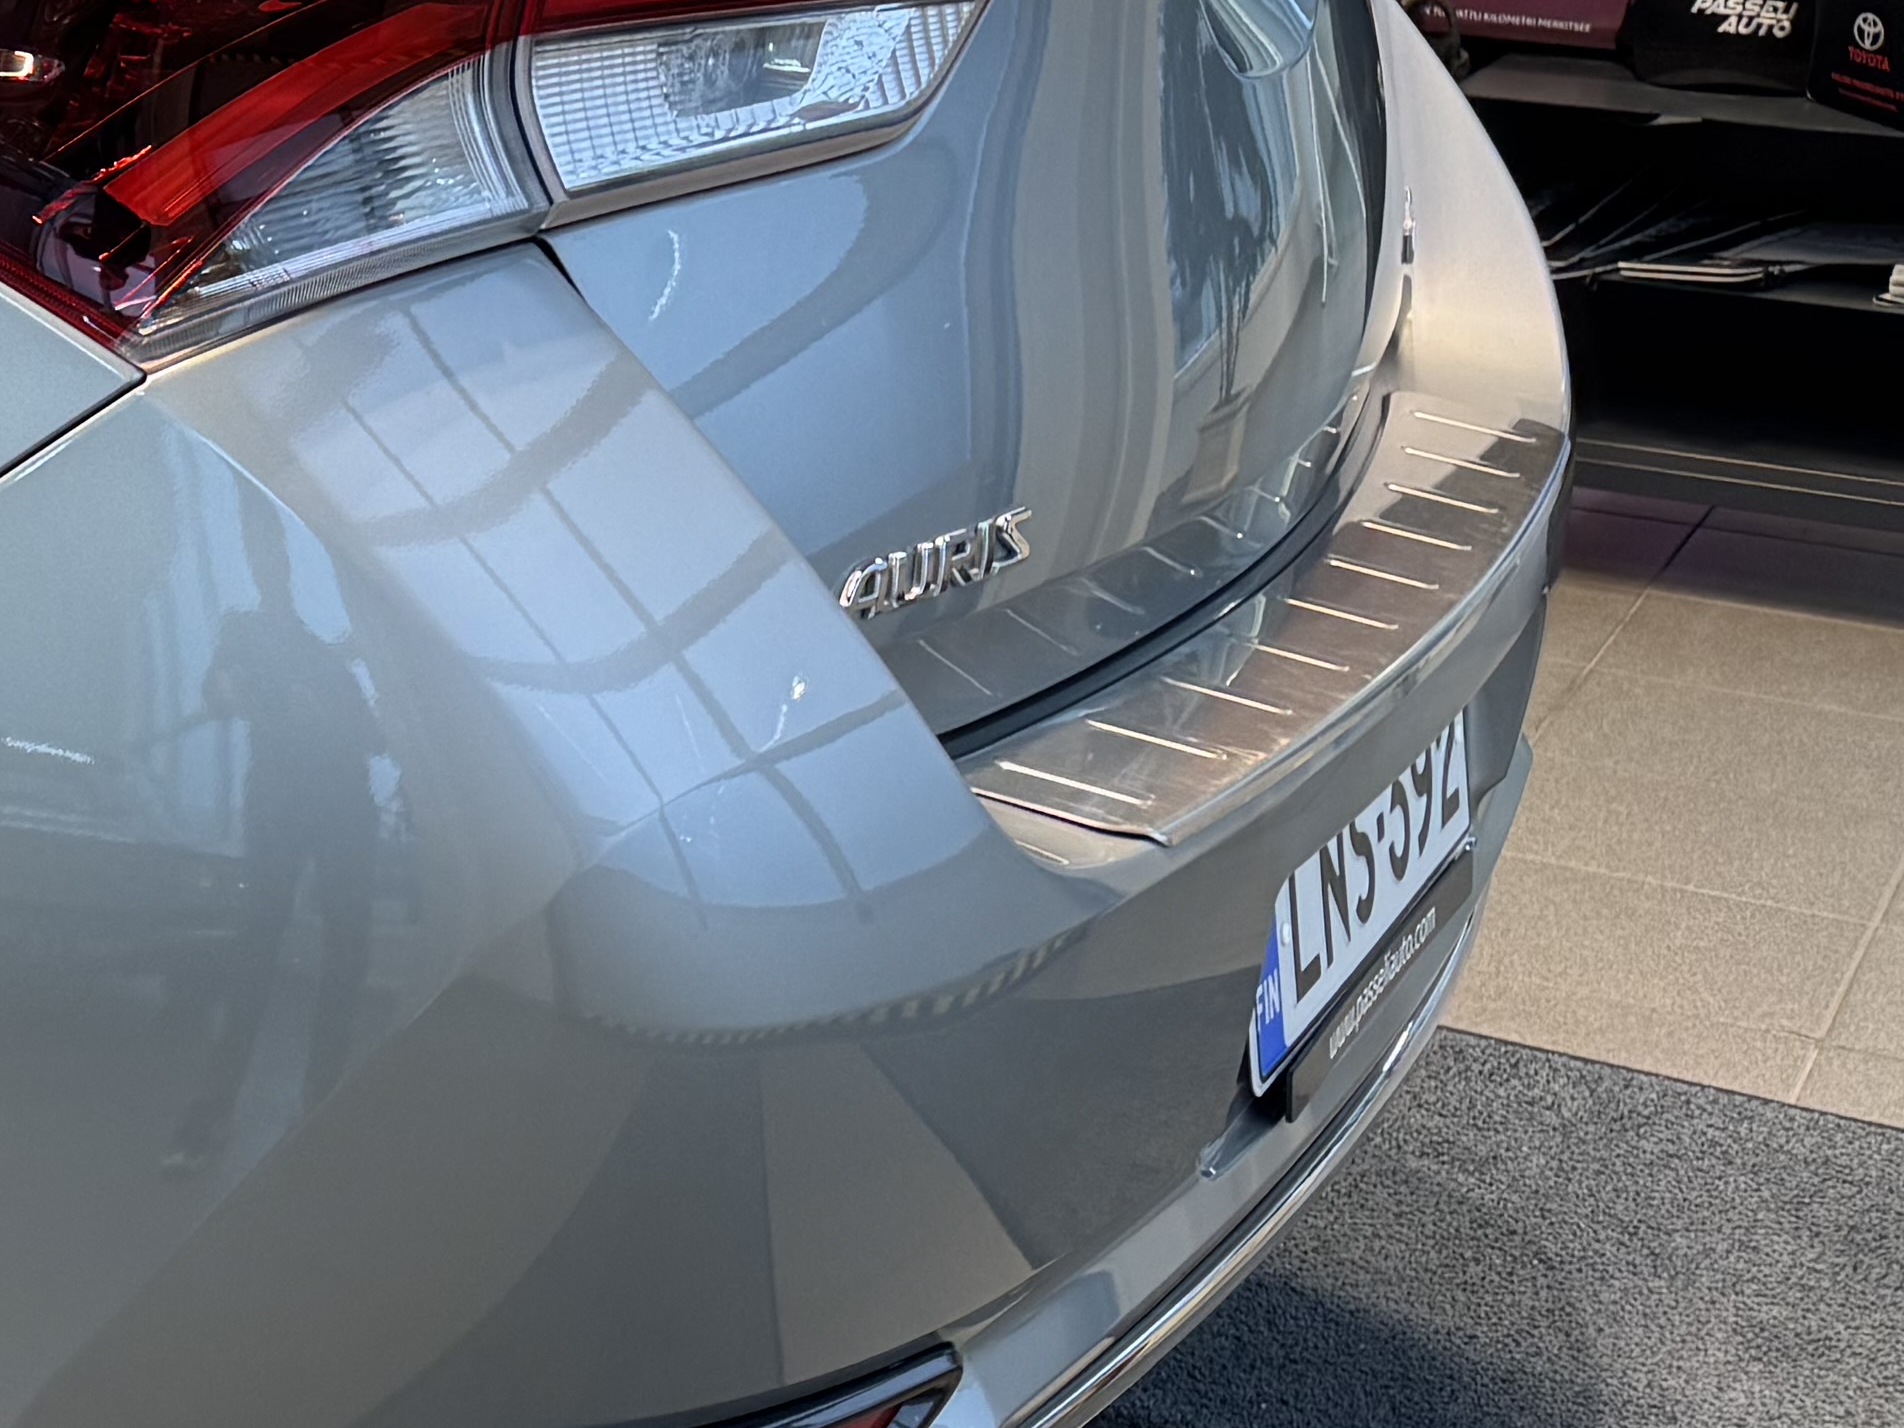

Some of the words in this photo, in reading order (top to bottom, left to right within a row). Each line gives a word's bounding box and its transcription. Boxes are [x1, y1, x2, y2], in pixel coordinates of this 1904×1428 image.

[1717, 15, 1792, 39] AUTO
[1848, 45, 1890, 72] TOYOTA
[839, 505, 1033, 620] AURIS
[1255, 968, 1281, 1034] FIN
